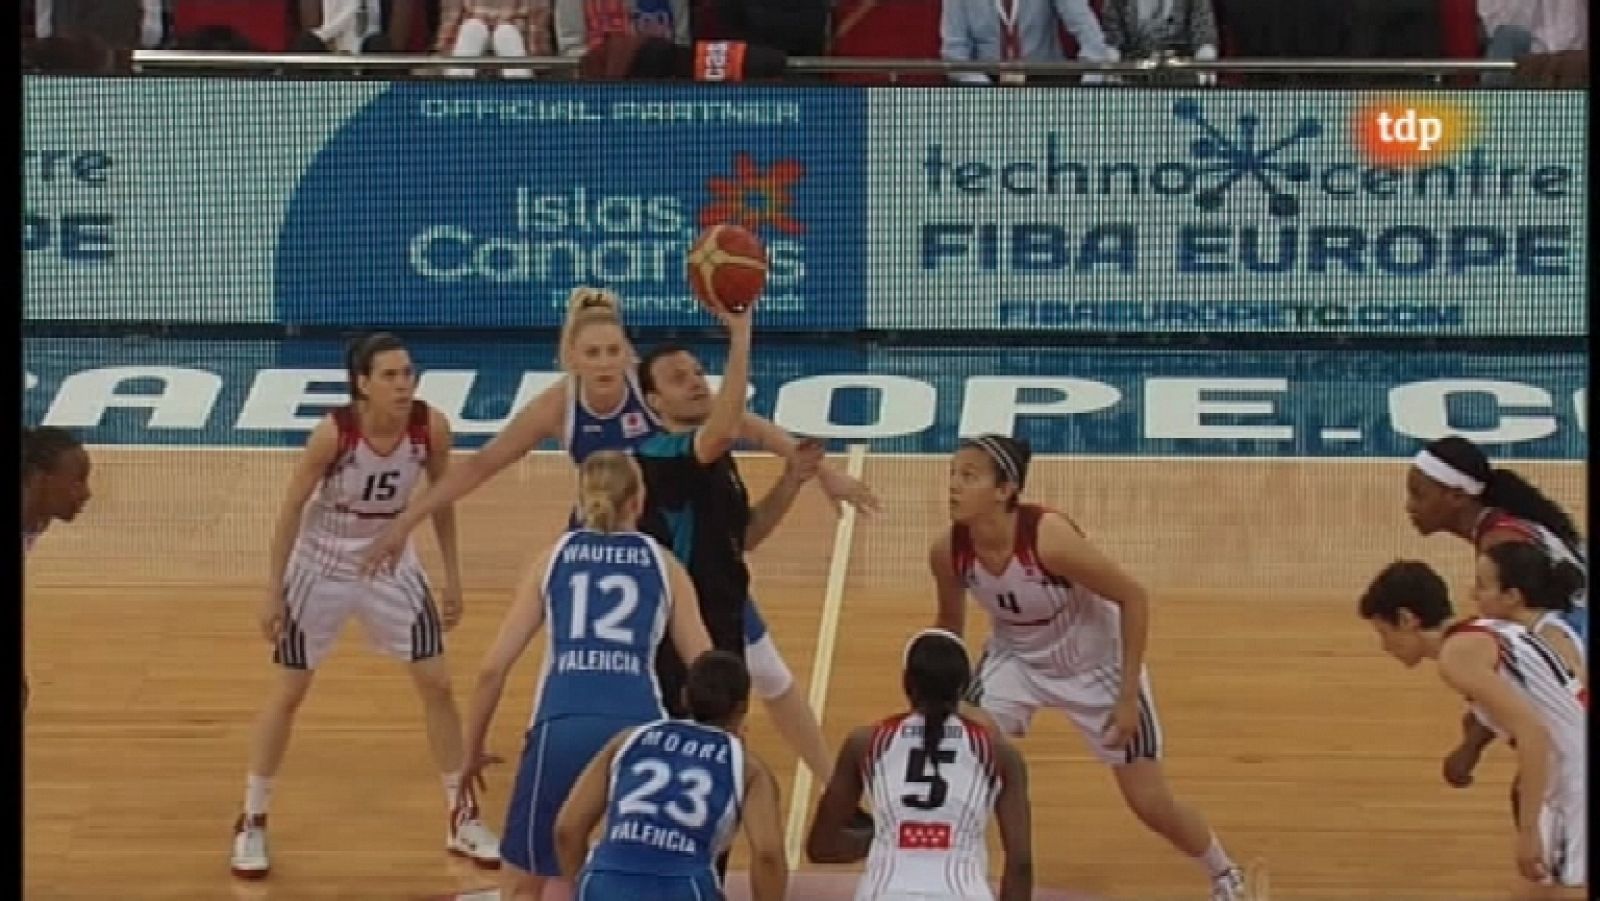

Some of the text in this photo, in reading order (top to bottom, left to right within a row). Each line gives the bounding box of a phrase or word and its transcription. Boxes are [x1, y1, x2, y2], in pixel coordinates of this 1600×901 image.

[420, 98, 800, 123] OFFICIAL PARTNER
[923, 131, 1198, 197] techno
[517, 185, 684, 232] Islas
[409, 224, 805, 282] Canars
[921, 223, 1571, 276] FIBA EUROPE
[361, 470, 401, 502] 15
[563, 542, 652, 568] WAUTERS
[568, 572, 640, 645] 12
[996, 591, 1021, 614] 4
[557, 651, 641, 676] VALENCIA
[641, 730, 729, 764] MOORE
[618, 757, 714, 828] 23
[900, 746, 958, 810] 5
[610, 822, 697, 854] VALENCIA
